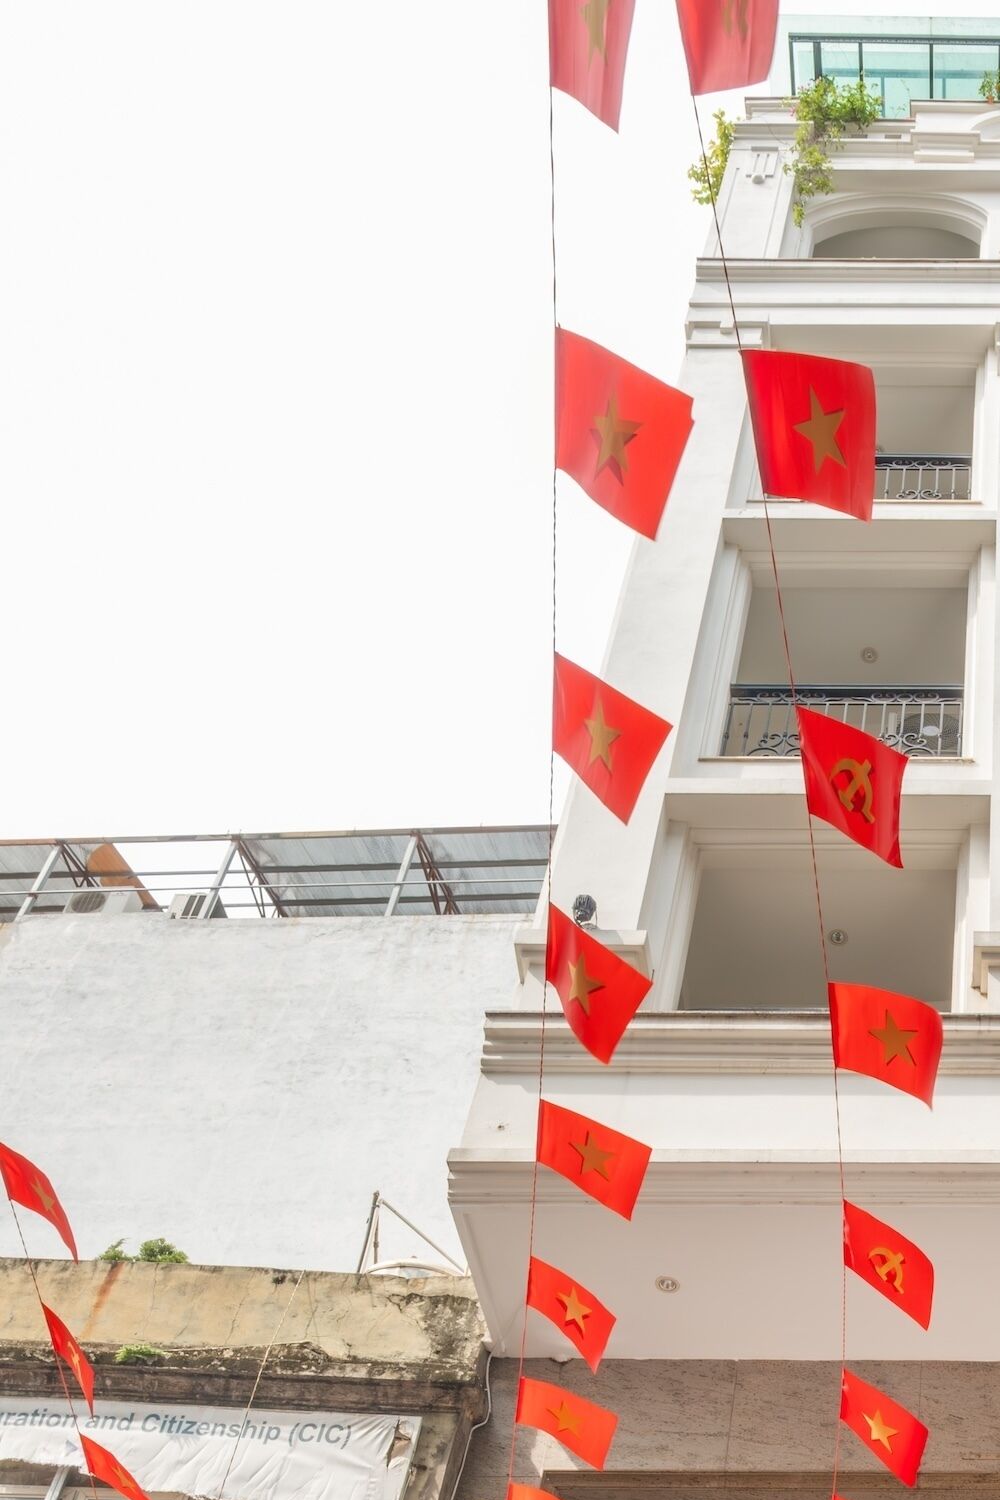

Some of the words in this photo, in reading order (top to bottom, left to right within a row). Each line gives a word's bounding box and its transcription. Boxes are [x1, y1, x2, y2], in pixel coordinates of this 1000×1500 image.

[0, 1408, 78, 1428] ration
[86, 1412, 135, 1431] and
[141, 1413, 281, 1445] Citizenship
[288, 1422, 352, 1450] (CIC)
